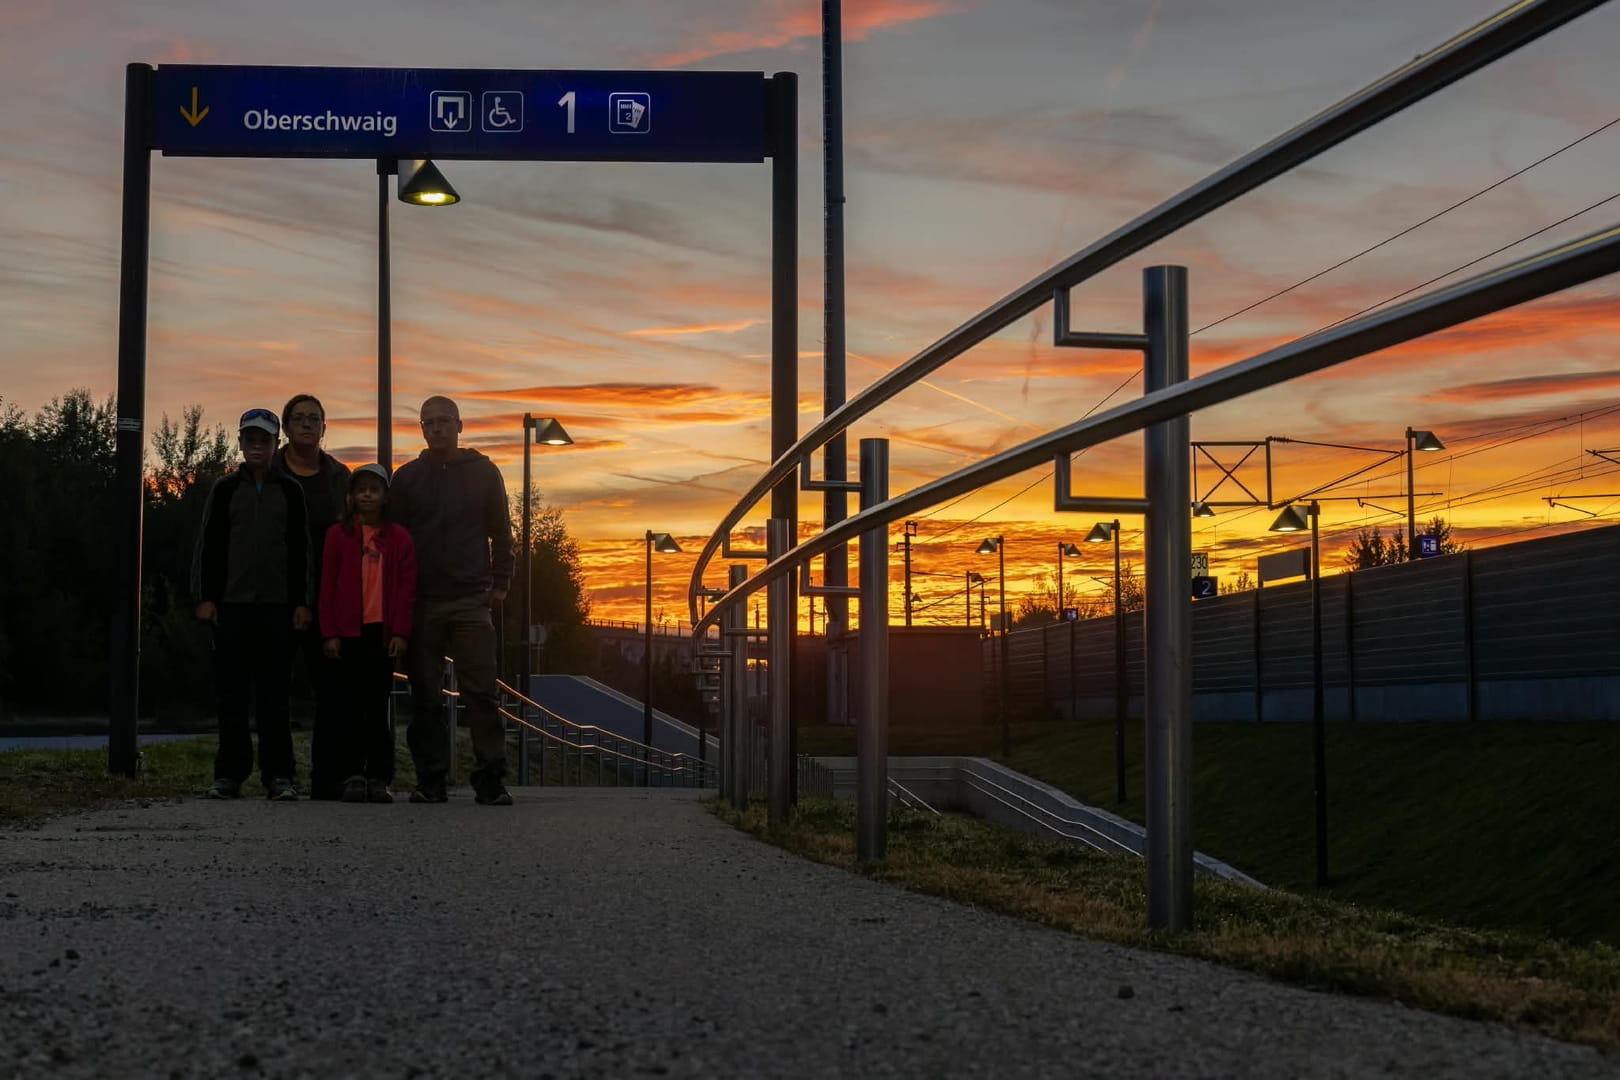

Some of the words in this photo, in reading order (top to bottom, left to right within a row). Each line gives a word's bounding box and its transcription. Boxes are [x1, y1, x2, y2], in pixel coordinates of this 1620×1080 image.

[243, 108, 398, 137] Oberschwaig
[556, 90, 577, 134] 1
[1201, 580, 1213, 595] 2
